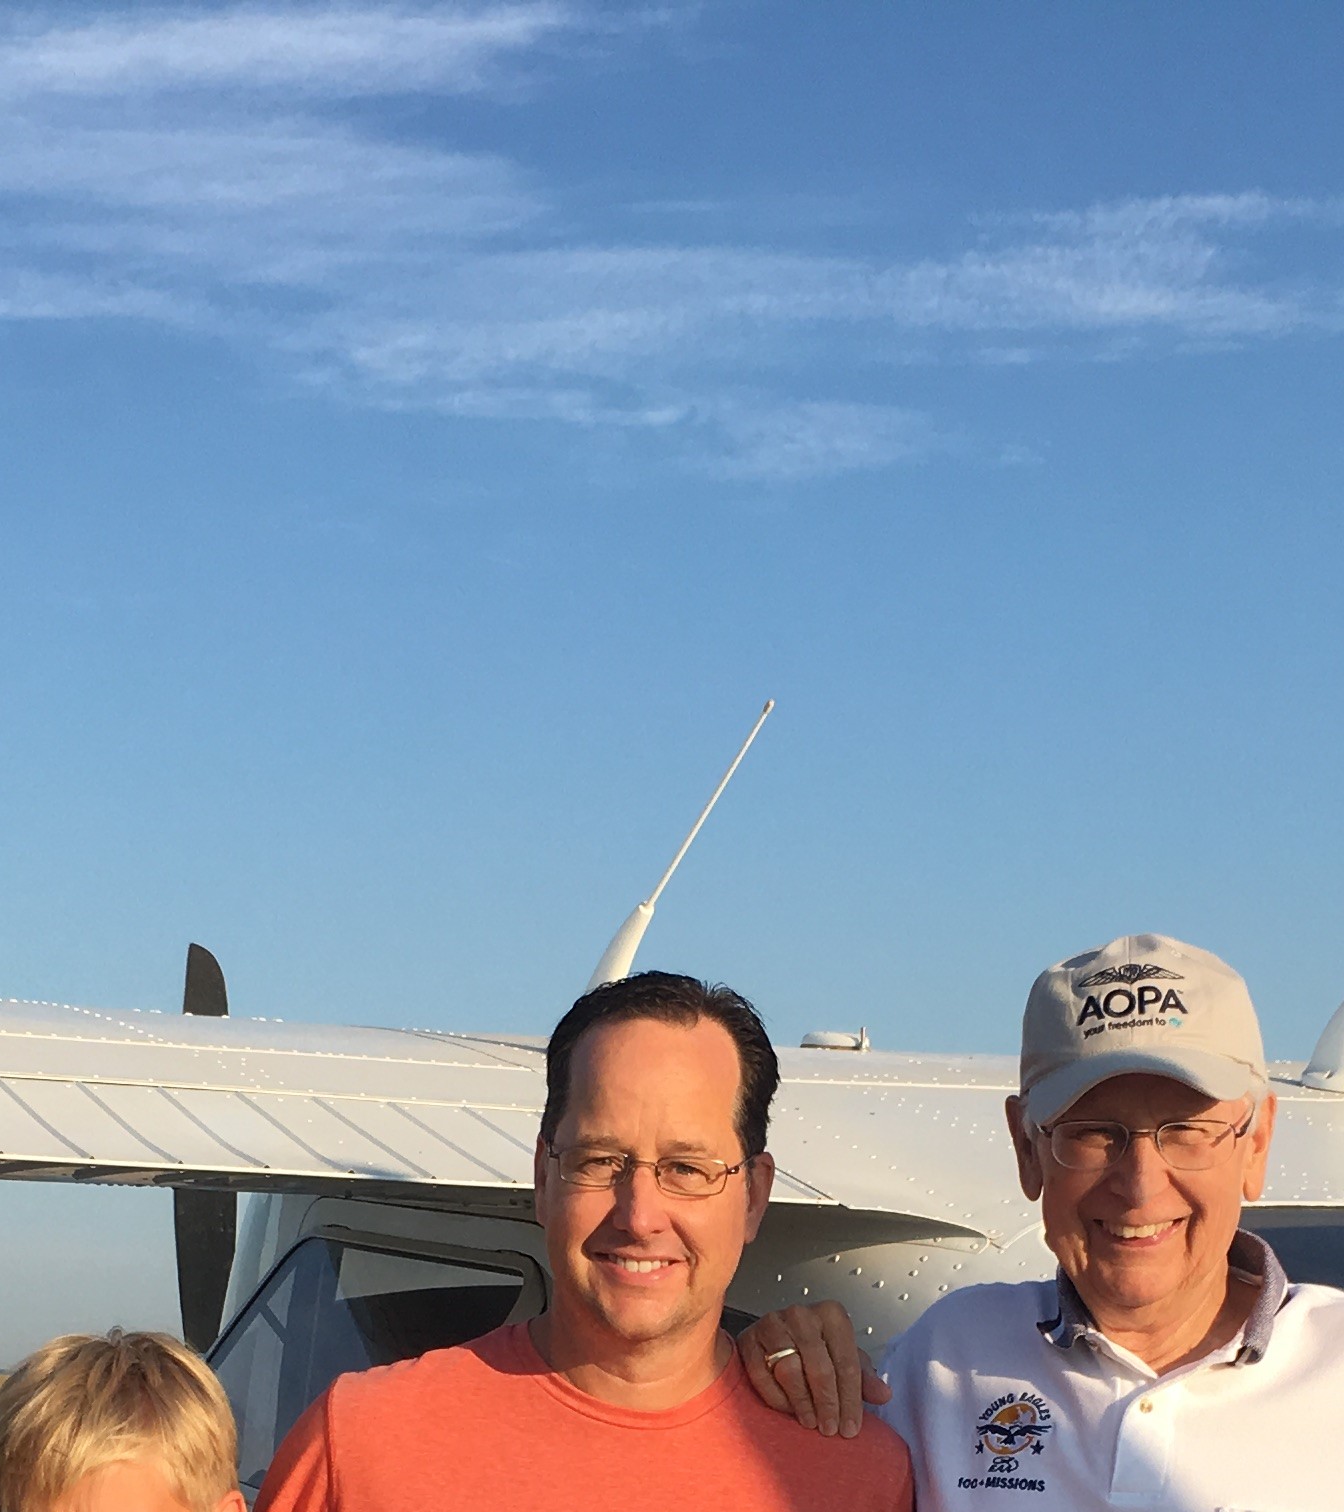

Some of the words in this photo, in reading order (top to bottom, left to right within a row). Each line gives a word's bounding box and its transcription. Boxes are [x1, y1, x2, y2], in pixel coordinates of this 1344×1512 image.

[1076, 985, 1188, 1026] AOPA
[1108, 1017, 1153, 1031] freedom
[1155, 1016, 1167, 1026] to
[979, 1393, 1015, 1421] YOUNG
[1019, 1392, 1051, 1421] EAGLES
